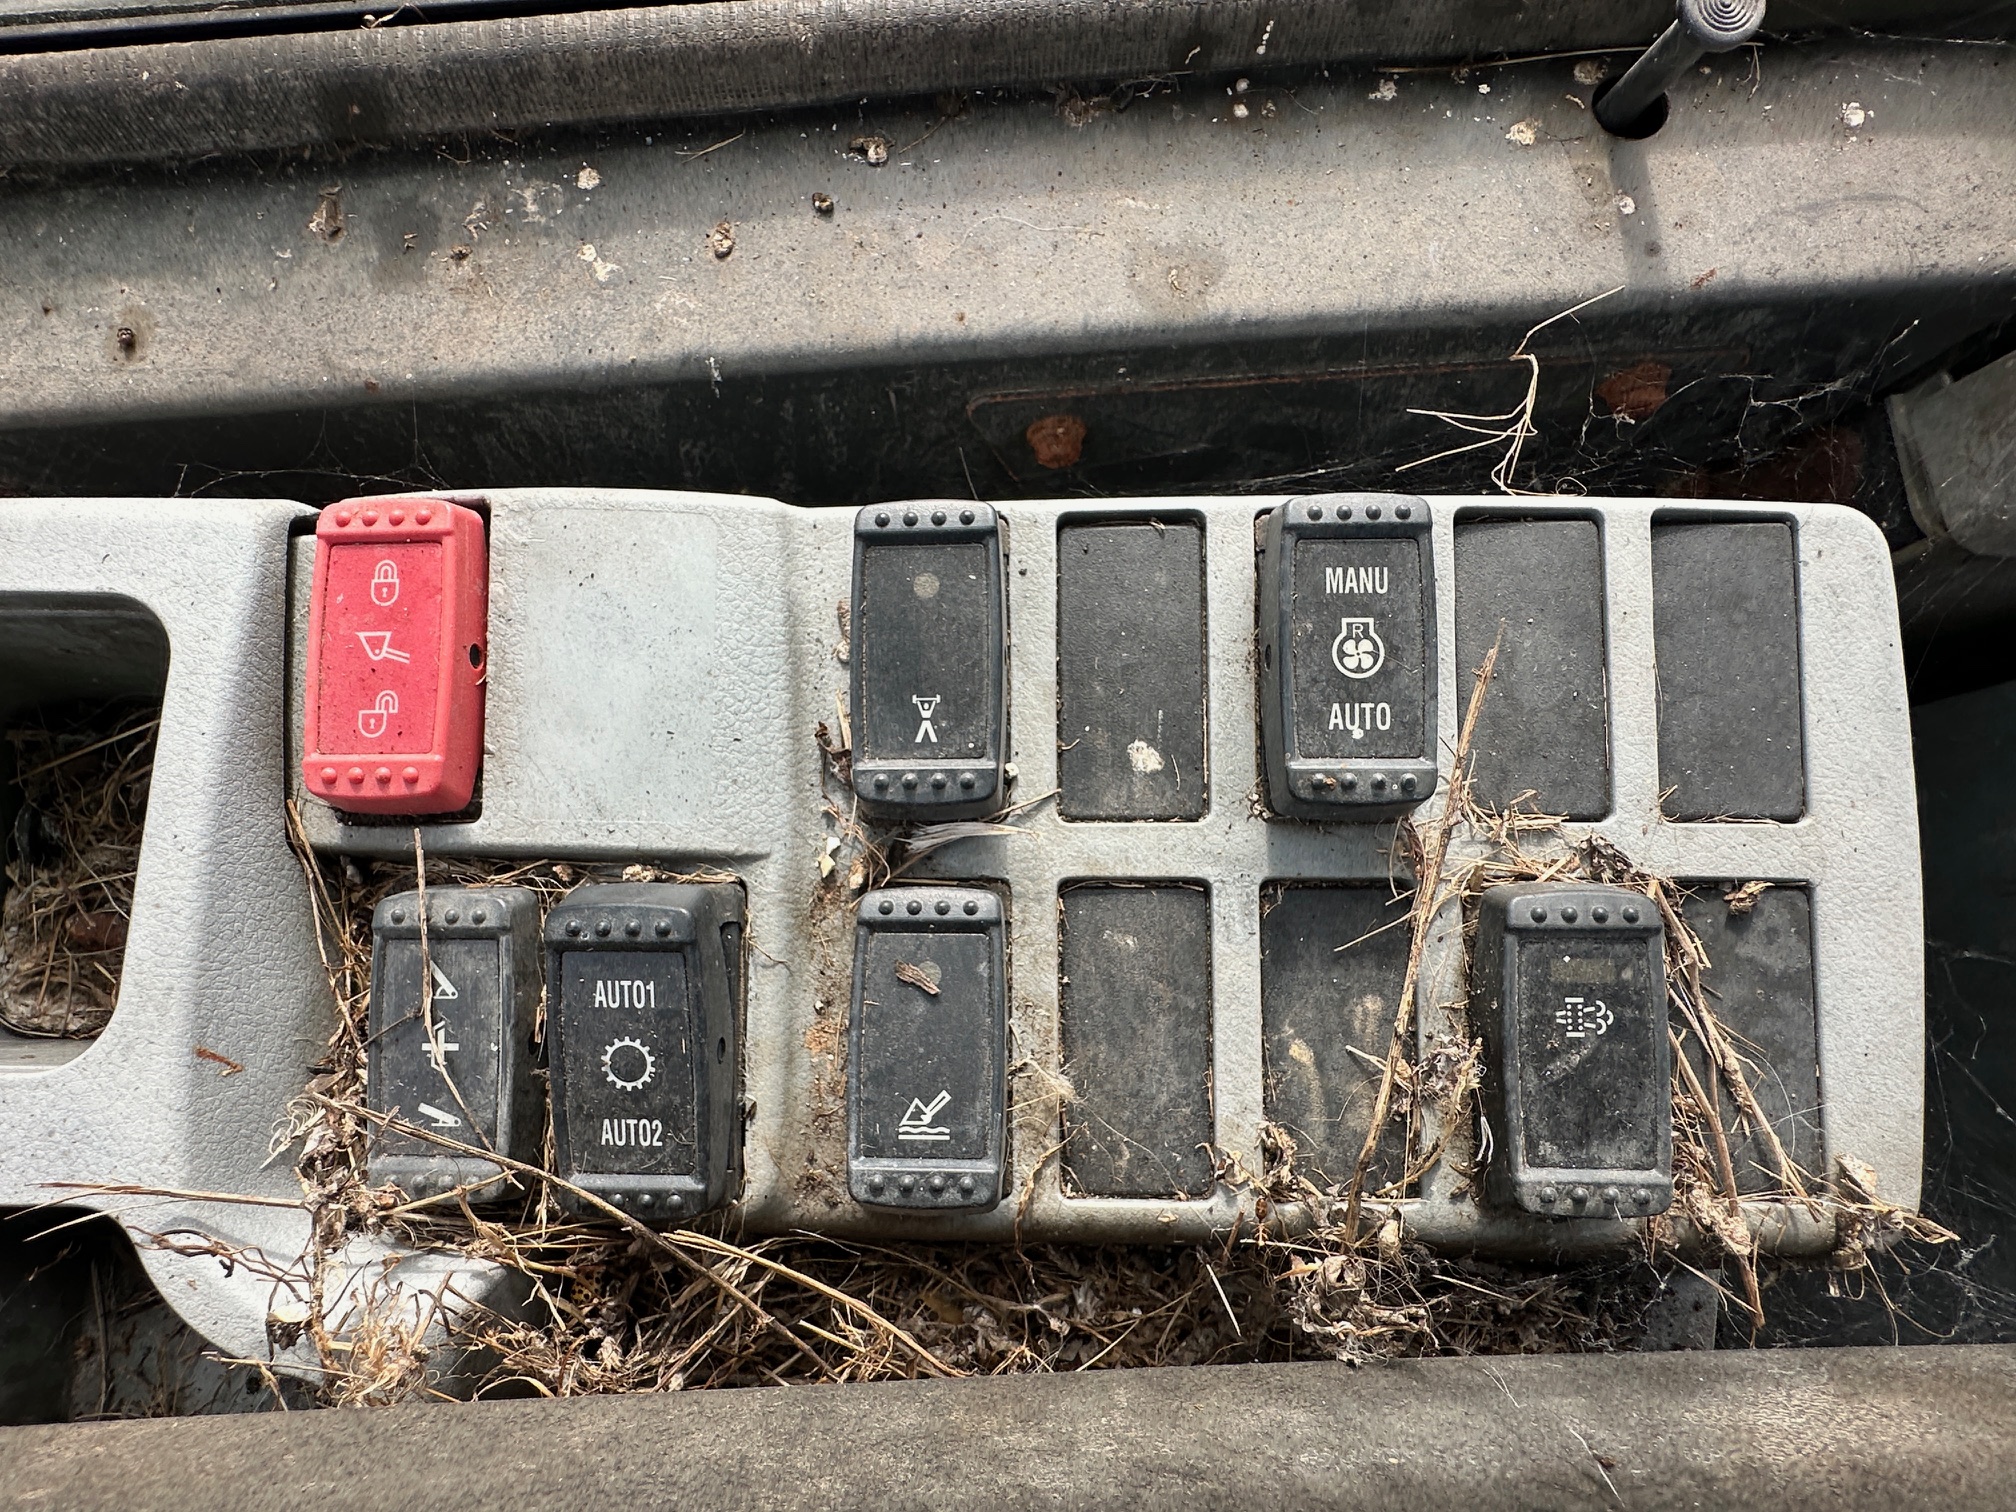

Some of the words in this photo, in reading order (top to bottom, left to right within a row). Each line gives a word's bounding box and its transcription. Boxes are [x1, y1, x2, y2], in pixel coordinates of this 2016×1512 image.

[1325, 566, 1389, 594] MANU
[1352, 623, 1364, 639] R
[1328, 702, 1391, 731] AUTO
[594, 980, 655, 1009] AUTO1
[601, 1118, 663, 1147] AUTO2
